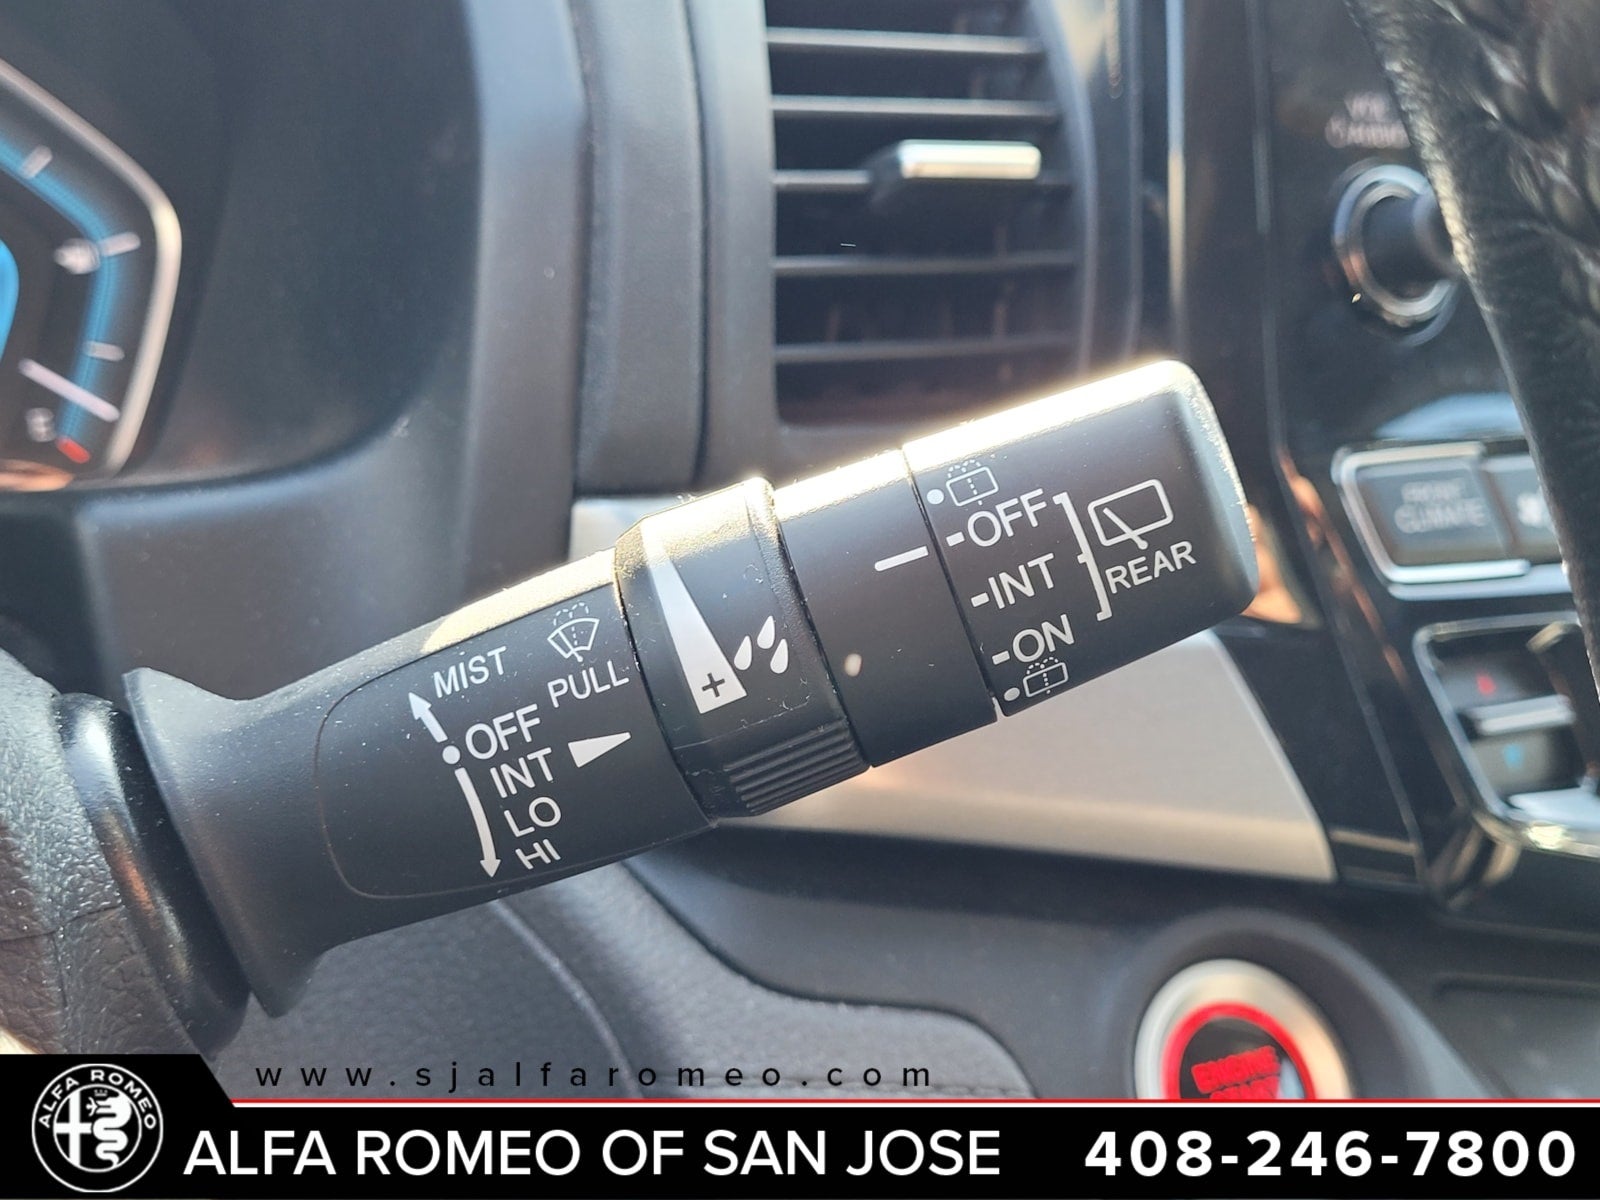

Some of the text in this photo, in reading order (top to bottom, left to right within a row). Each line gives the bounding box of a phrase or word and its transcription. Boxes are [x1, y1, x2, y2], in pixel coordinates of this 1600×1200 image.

[967, 488, 1047, 547] OFF
[988, 553, 1054, 609] INT
[1105, 541, 1197, 594] REAR
[1012, 614, 1075, 662] ON
[433, 646, 507, 698] MIST
[547, 661, 630, 708] PULL
[465, 704, 541, 759] OFF
[490, 747, 554, 798] INT
[504, 797, 562, 837] LO
[515, 839, 561, 870] HI
